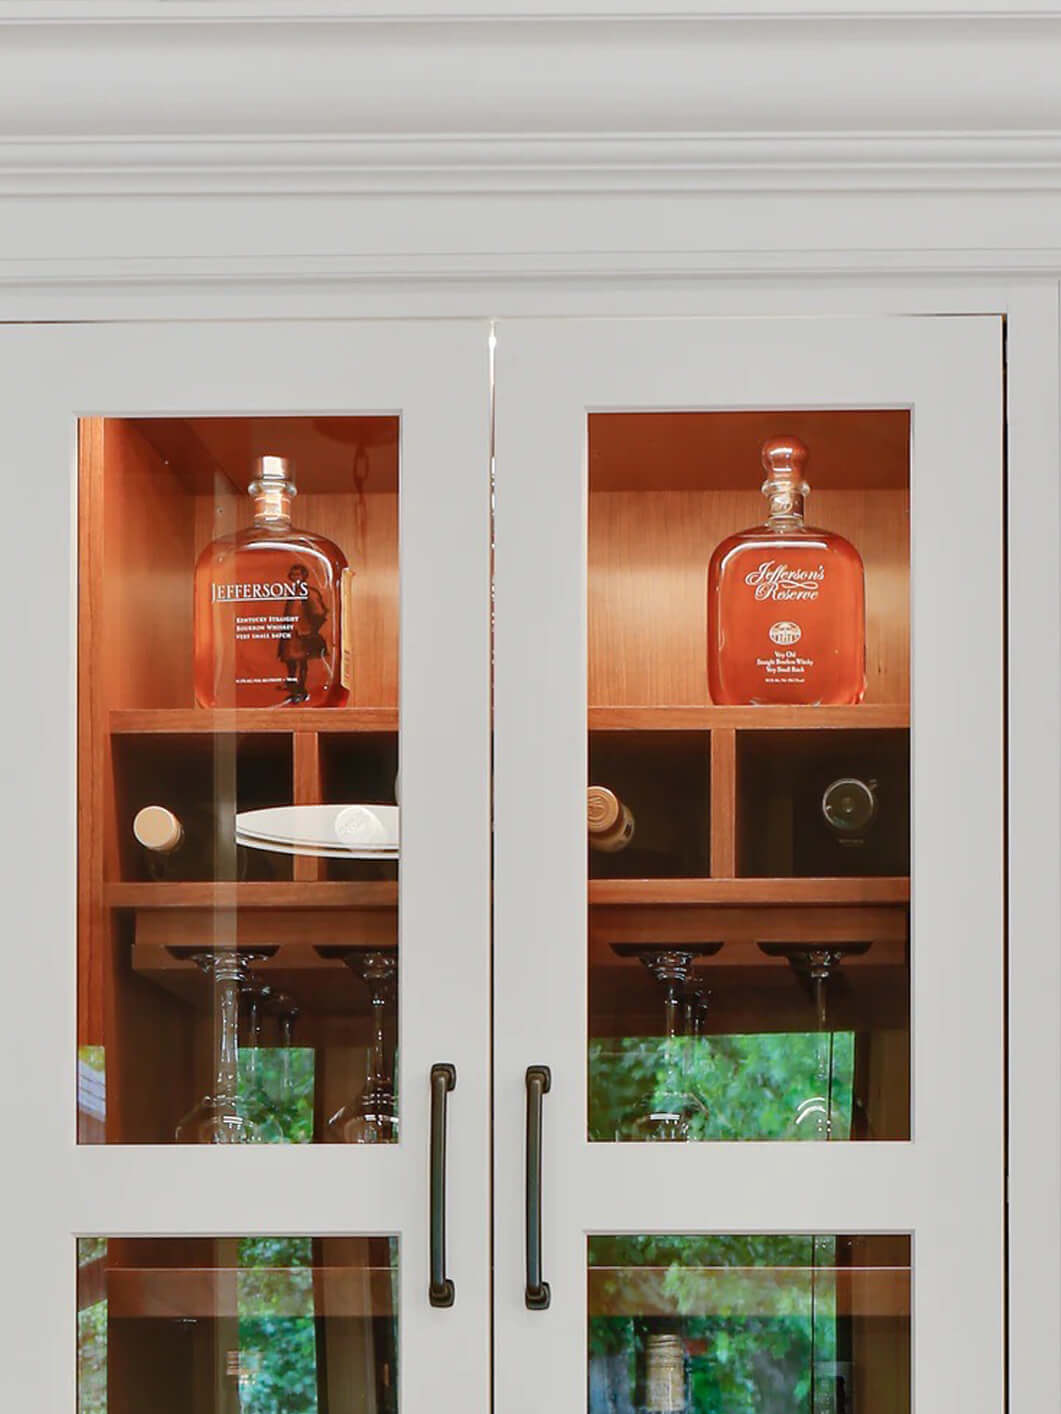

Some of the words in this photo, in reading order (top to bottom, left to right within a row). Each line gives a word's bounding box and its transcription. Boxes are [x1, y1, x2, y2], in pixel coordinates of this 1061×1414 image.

[745, 560, 825, 585] Jefferson's
[211, 579, 309, 603] JEFFERSON'S
[754, 582, 819, 601] Reserve
